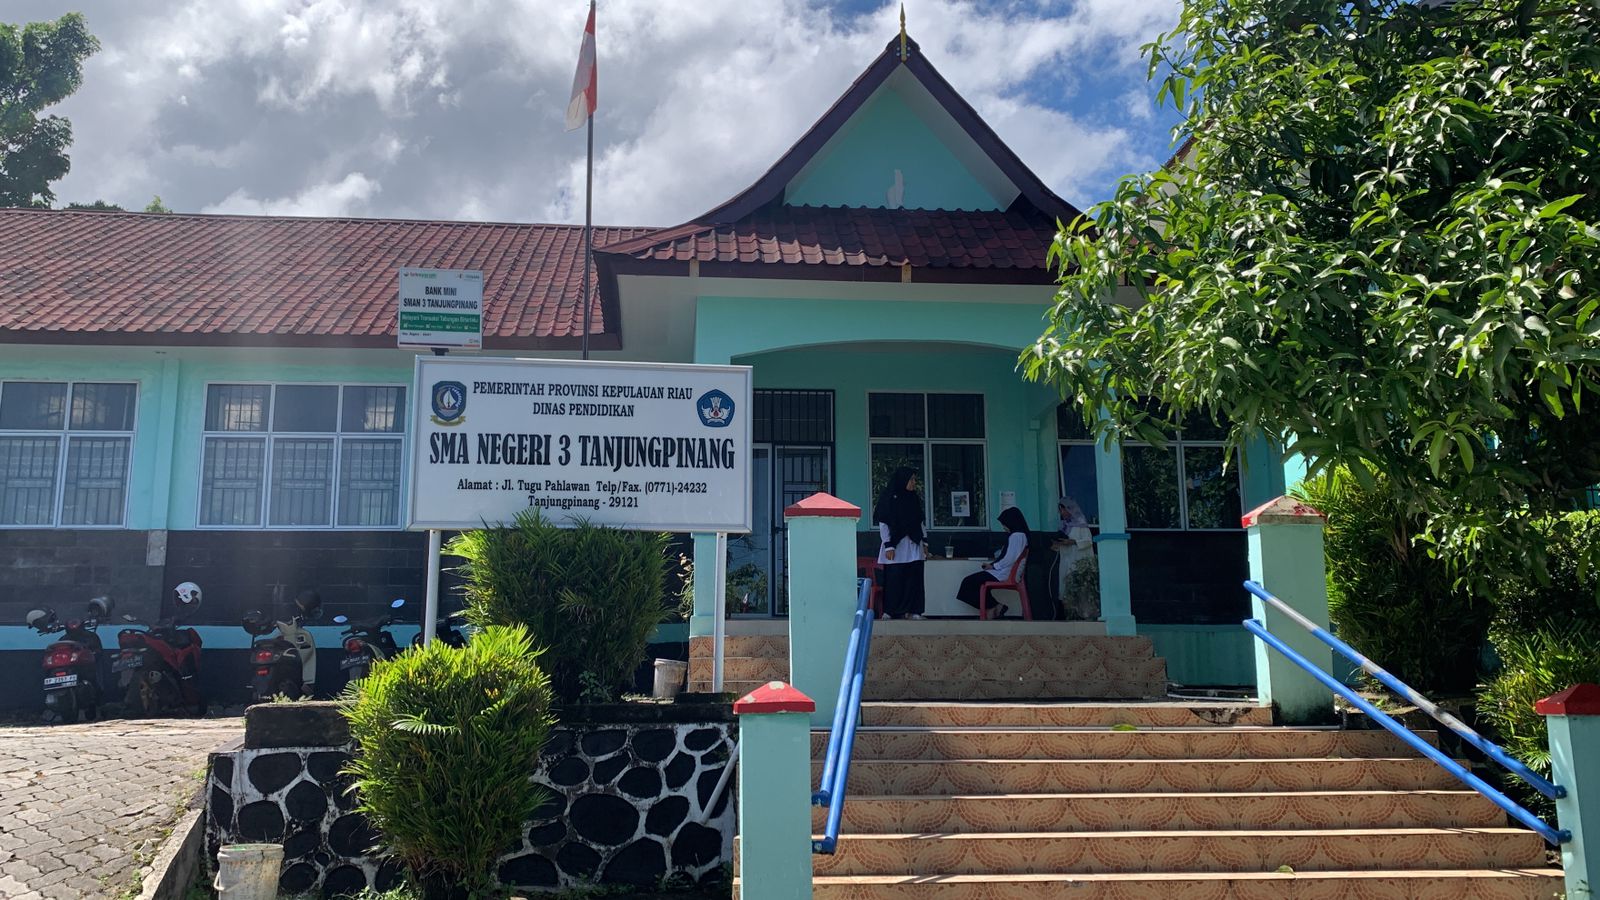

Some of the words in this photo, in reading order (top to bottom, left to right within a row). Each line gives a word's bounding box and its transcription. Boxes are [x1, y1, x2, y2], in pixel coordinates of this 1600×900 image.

[425, 286, 442, 296] BANK
[444, 287, 457, 296] MINI
[404, 298, 420, 308] SMAN
[422, 299, 426, 308] 3
[428, 299, 478, 310] TANJUNGPINANG
[473, 382, 545, 396] PEMERINTAH
[548, 384, 598, 397] PROVINSI
[602, 385, 664, 399] KEPULAUAN
[667, 387, 692, 400] RIAU
[533, 402, 566, 416] DINAS
[569, 403, 634, 417] PENDIDIKAN
[430, 432, 470, 464] SMA
[476, 433, 552, 466] NEGERI
[558, 434, 571, 466] 3
[578, 435, 735, 472] TANJUNGPINANG
[457, 478, 492, 490] Alamat
[502, 479, 514, 491] Jl.
[518, 480, 542, 494] Tugu
[545, 480, 590, 492] Pahlawan
[596, 480, 642, 495] Telp/Fax.
[645, 481, 707, 496] (0771)-24232
[528, 496, 600, 510] Tanjungpinang
[609, 497, 638, 508] 29121
